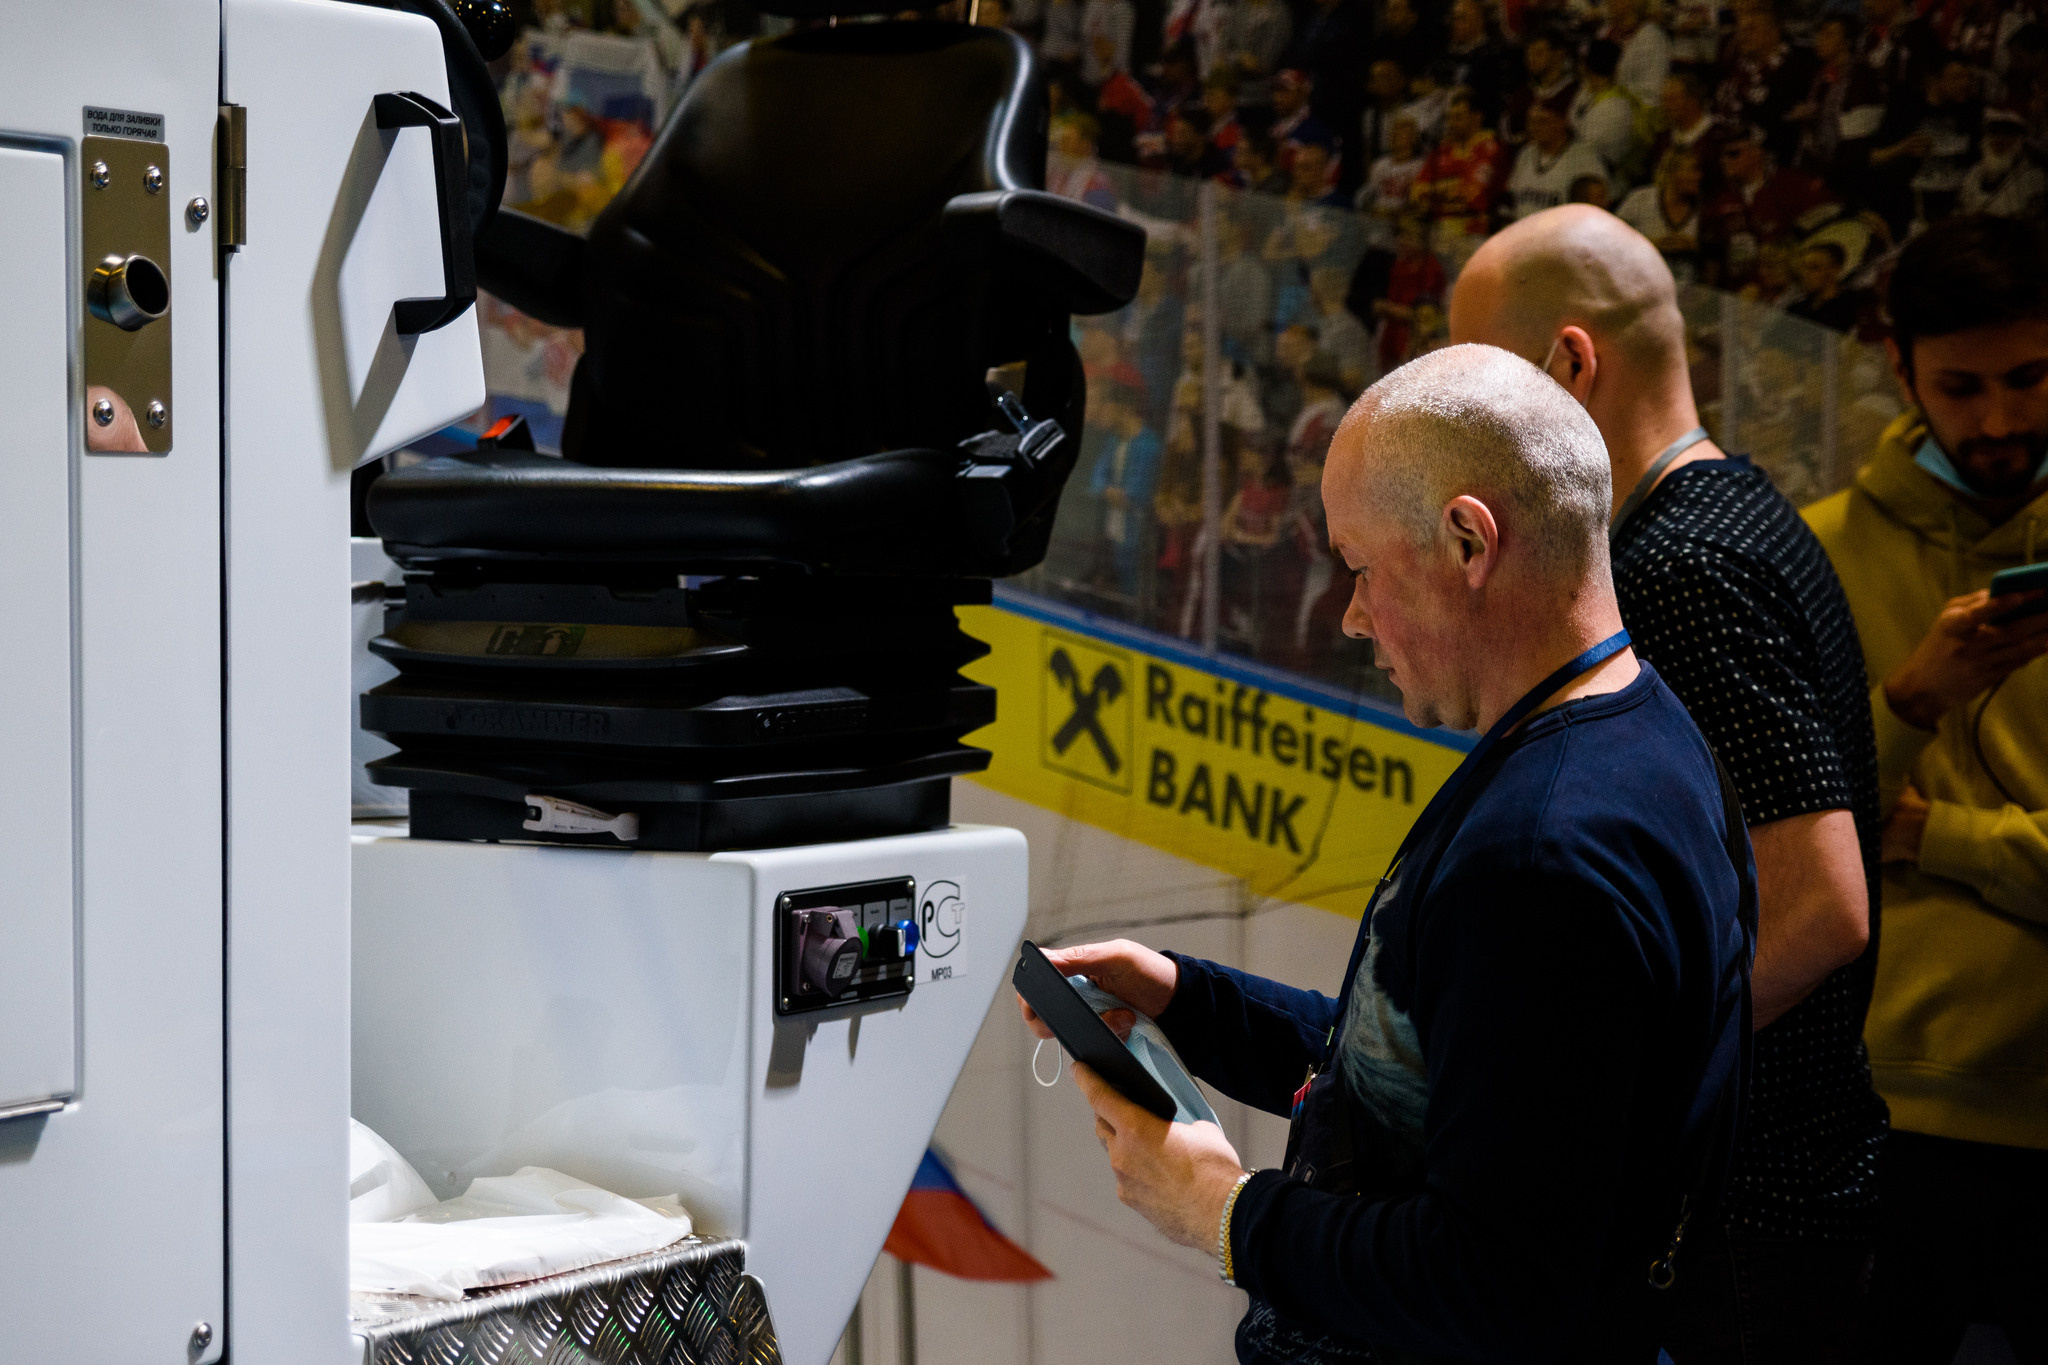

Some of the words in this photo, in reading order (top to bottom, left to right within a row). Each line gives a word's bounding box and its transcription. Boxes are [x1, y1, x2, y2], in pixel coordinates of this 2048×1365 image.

[87, 110, 107, 120] ВОДА
[109, 113, 125, 122] ДЛЯ
[126, 115, 161, 126] ЗАЛИВКИ
[92, 123, 121, 134] ТОЛЬКО
[123, 127, 157, 138] ГОРЯЧАЯ
[1145, 662, 1414, 803] Raiffeisen
[1147, 747, 1307, 855] BANK
